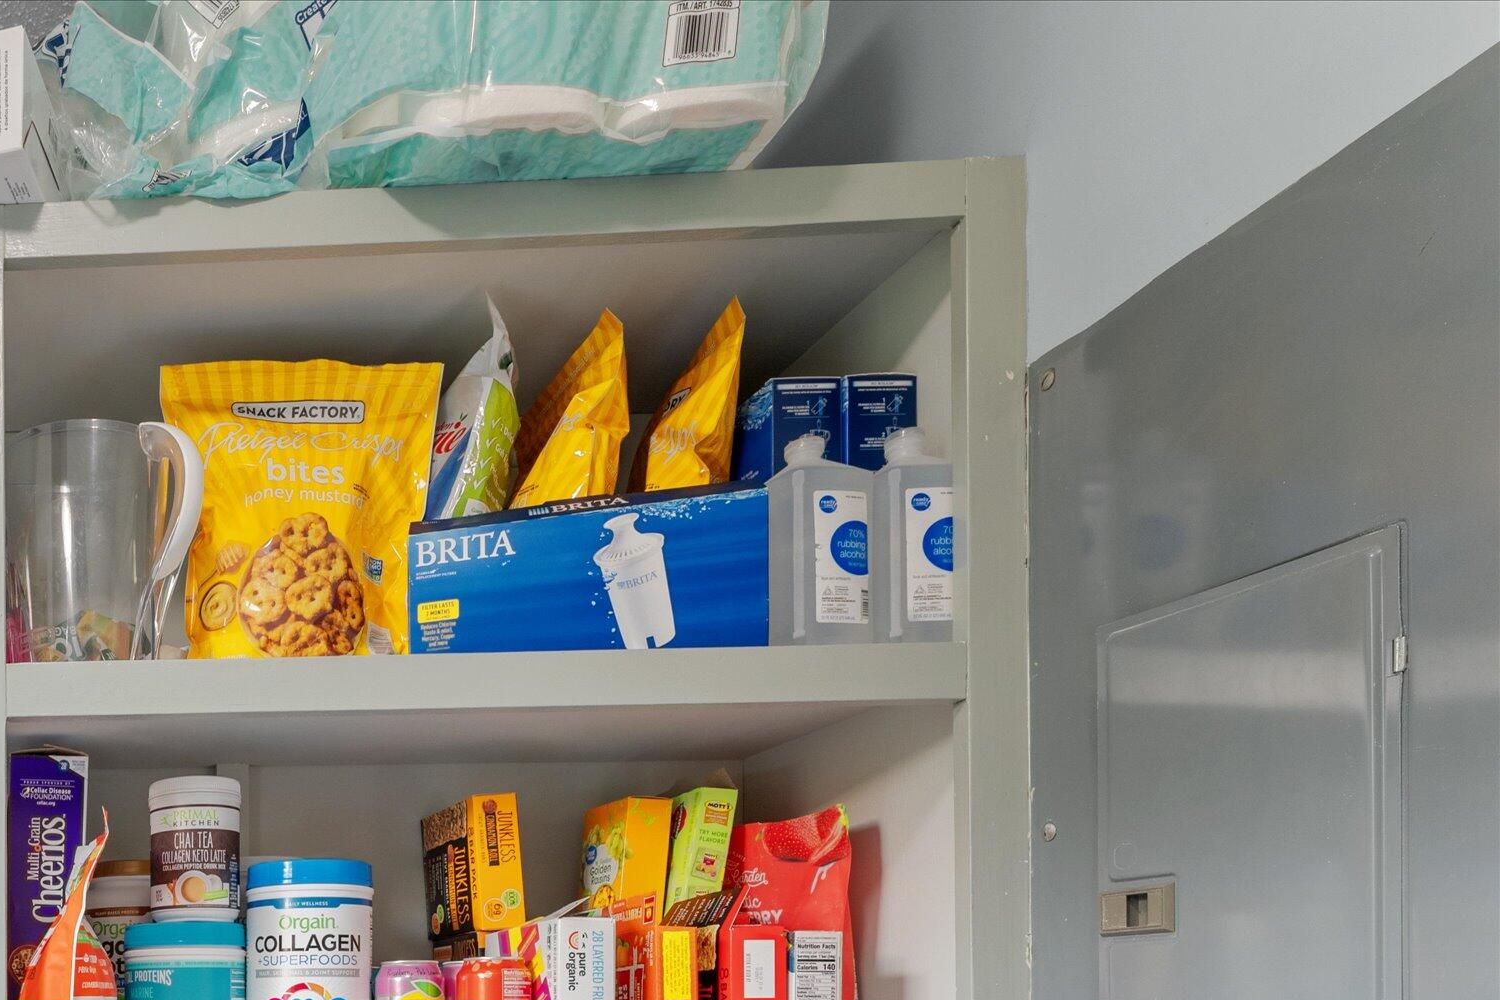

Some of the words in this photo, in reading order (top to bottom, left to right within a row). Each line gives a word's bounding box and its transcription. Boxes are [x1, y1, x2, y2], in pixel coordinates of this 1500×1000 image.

[237, 405, 287, 420] SNACK
[291, 404, 359, 420] FACTORY
[266, 458, 345, 483] bites
[245, 487, 293, 506] honey
[300, 489, 363, 510] mustard
[551, 496, 629, 514] BRITA
[416, 531, 516, 567] BRITA
[837, 540, 866, 551] rubbing
[840, 549, 866, 559] alcohol
[625, 570, 658, 587] BRITA
[172, 808, 219, 819] PRIMAL
[172, 818, 220, 827] KITCHEN
[174, 832, 194, 849] CHAI
[197, 831, 213, 848] TEA
[497, 810, 516, 863] JUNKLESS
[162, 849, 190, 863] COLLAGEN
[192, 850, 208, 863] KETO
[209, 849, 226, 864] LATTE
[31, 816, 66, 924] Cheerios
[453, 846, 470, 925] JUNKLESS
[279, 914, 336, 933] Orgain
[255, 934, 361, 953] COLLAGEN
[592, 930, 602, 943] 28
[578, 952, 586, 977] pure
[593, 945, 603, 980] LAYERED
[823, 963, 835, 971] 140
[567, 952, 576, 992] organic
